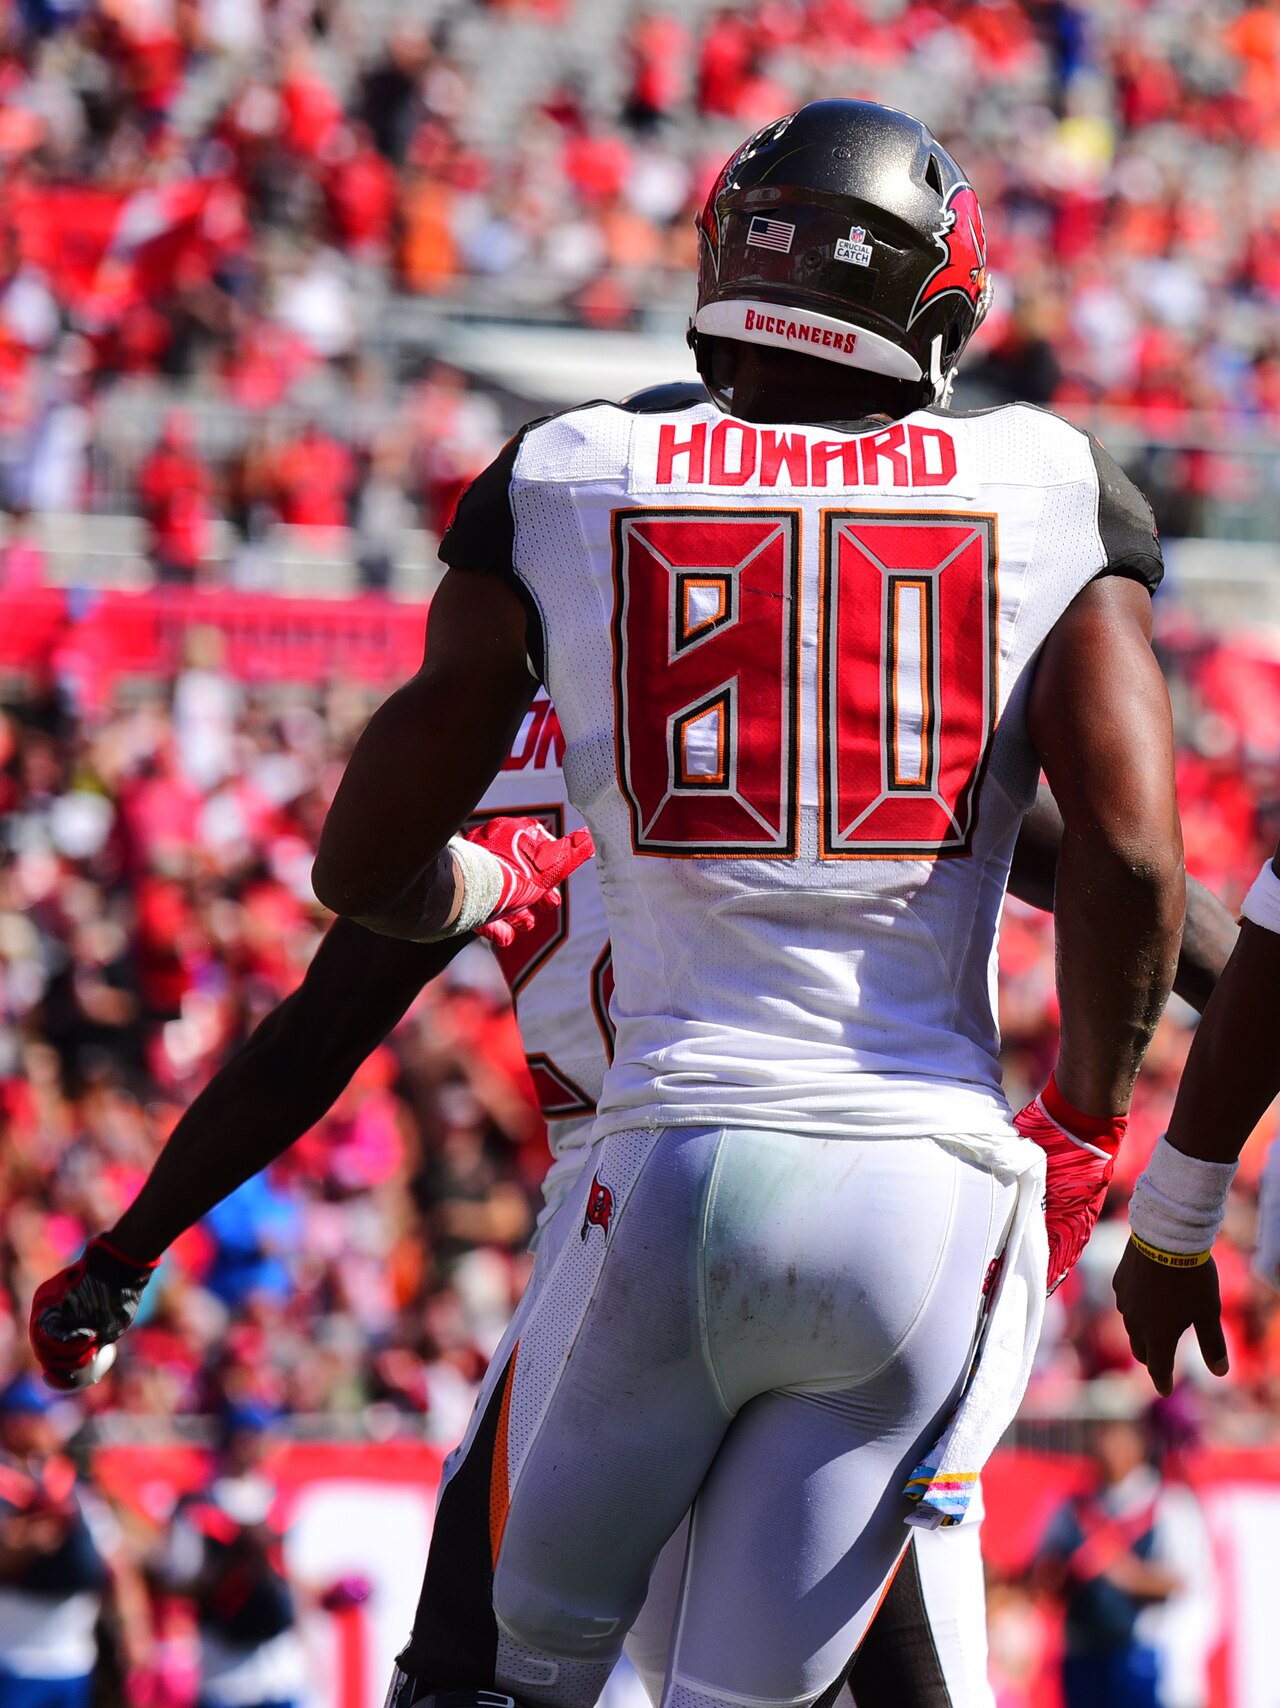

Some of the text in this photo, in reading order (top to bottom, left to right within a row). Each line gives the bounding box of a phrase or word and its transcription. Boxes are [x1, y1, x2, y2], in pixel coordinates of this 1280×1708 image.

[837, 248, 869, 262] CATCH
[838, 240, 870, 254] CRUCIAL
[655, 418, 958, 487] HOWARD
[610, 506, 998, 860] 80
